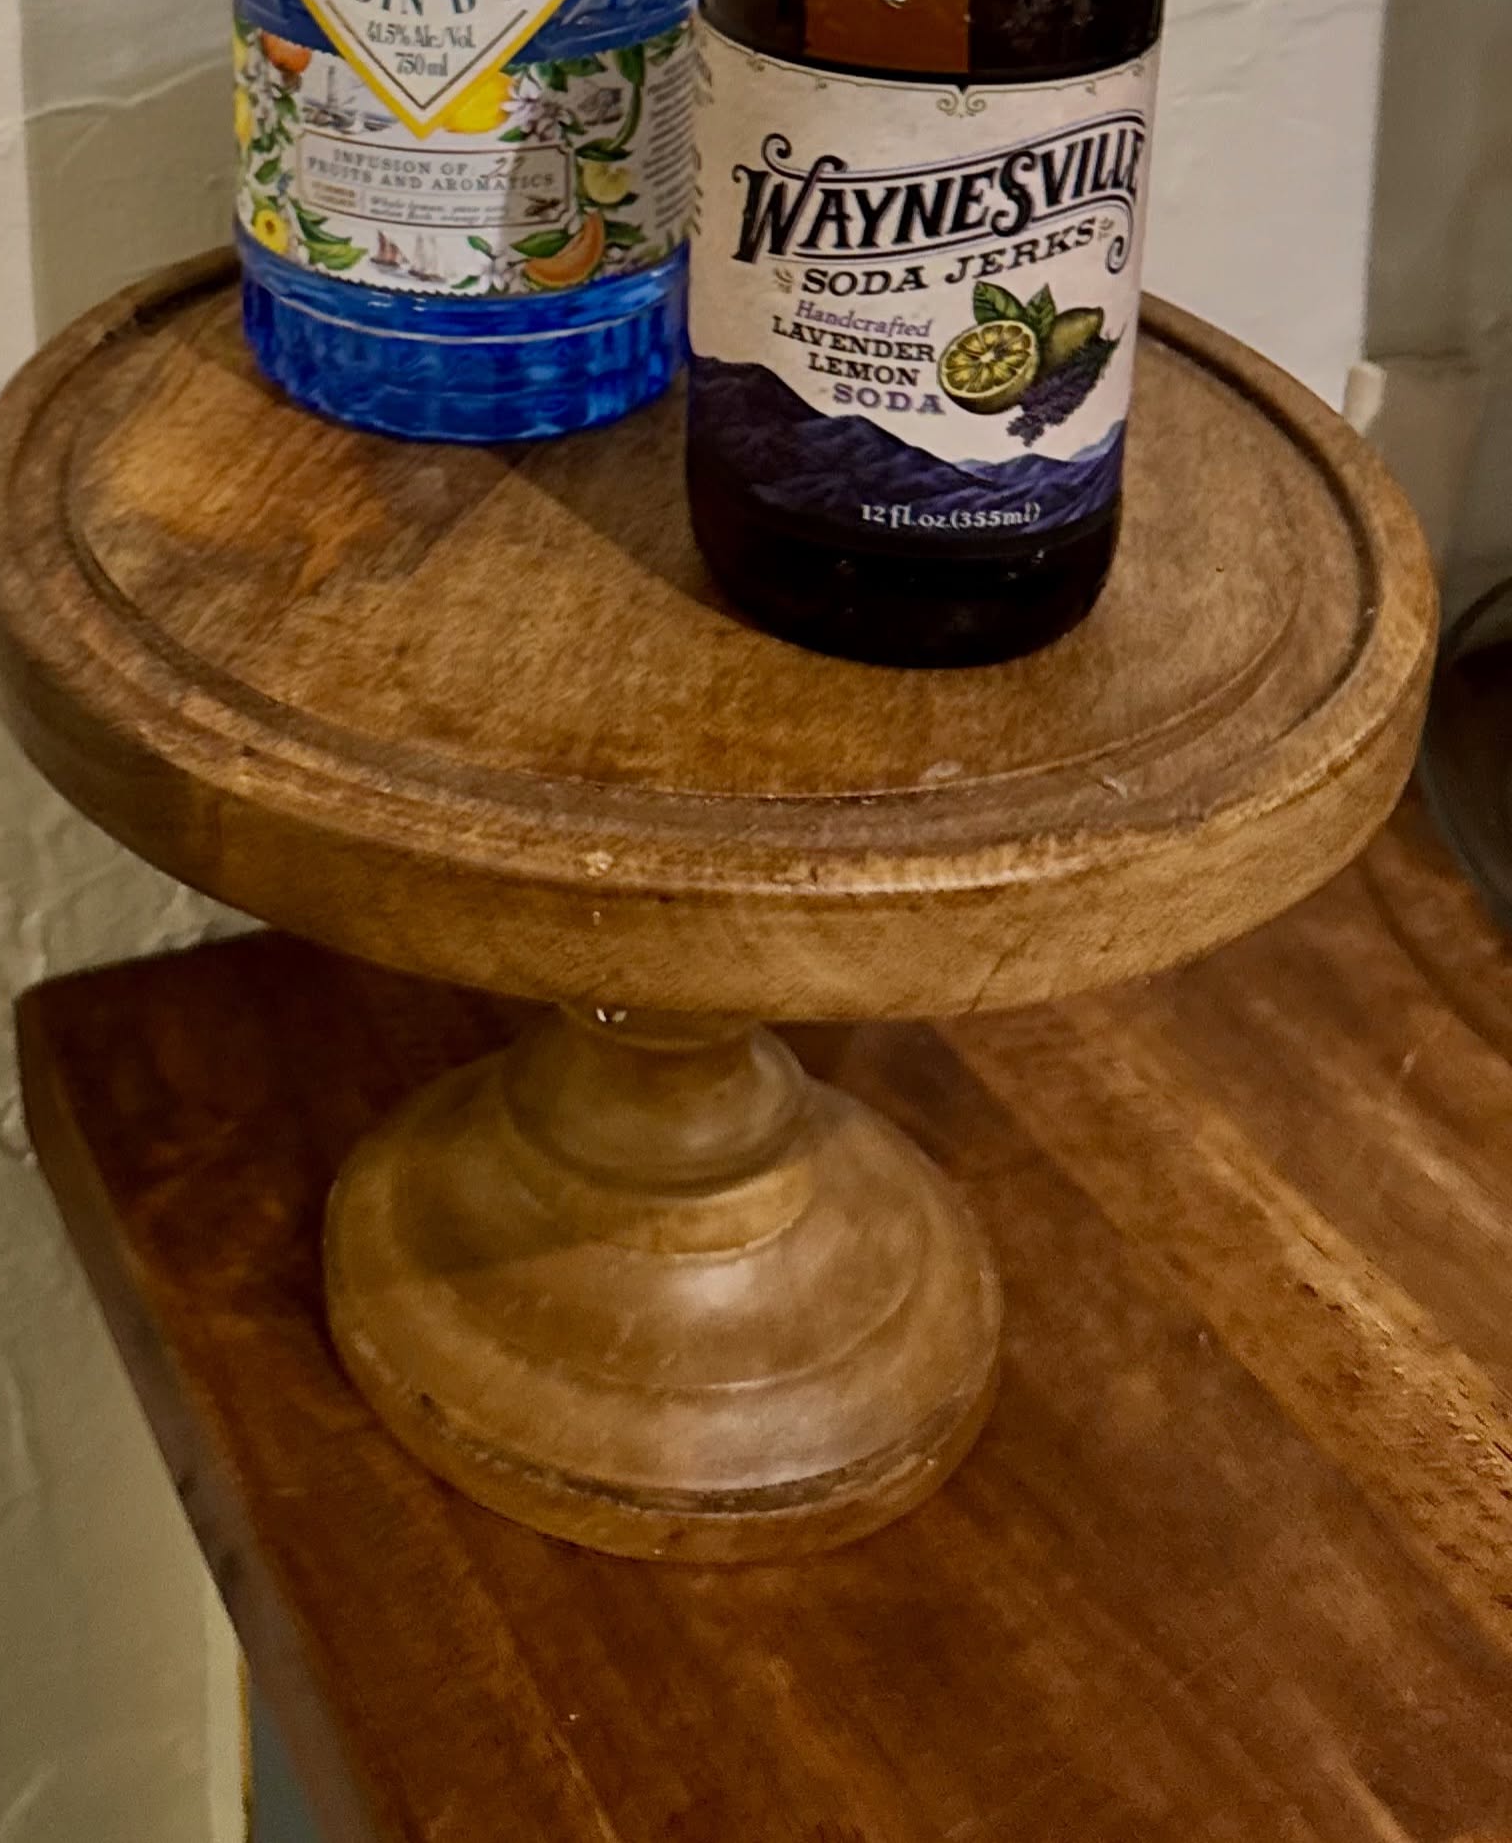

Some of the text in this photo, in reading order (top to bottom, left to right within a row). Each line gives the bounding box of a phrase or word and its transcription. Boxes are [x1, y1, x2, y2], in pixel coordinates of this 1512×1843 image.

[394, 51, 426, 76] 750
[308, 156, 554, 192] FRUITS AND AROMATICS
[334, 148, 432, 175] INFUSION
[439, 161, 469, 176] OF
[801, 216, 1098, 297] SODA JERKS
[795, 300, 935, 338] Handcrafted
[772, 315, 937, 363] LAVENDER
[807, 351, 921, 388] LEMON
[832, 382, 947, 415] SODA
